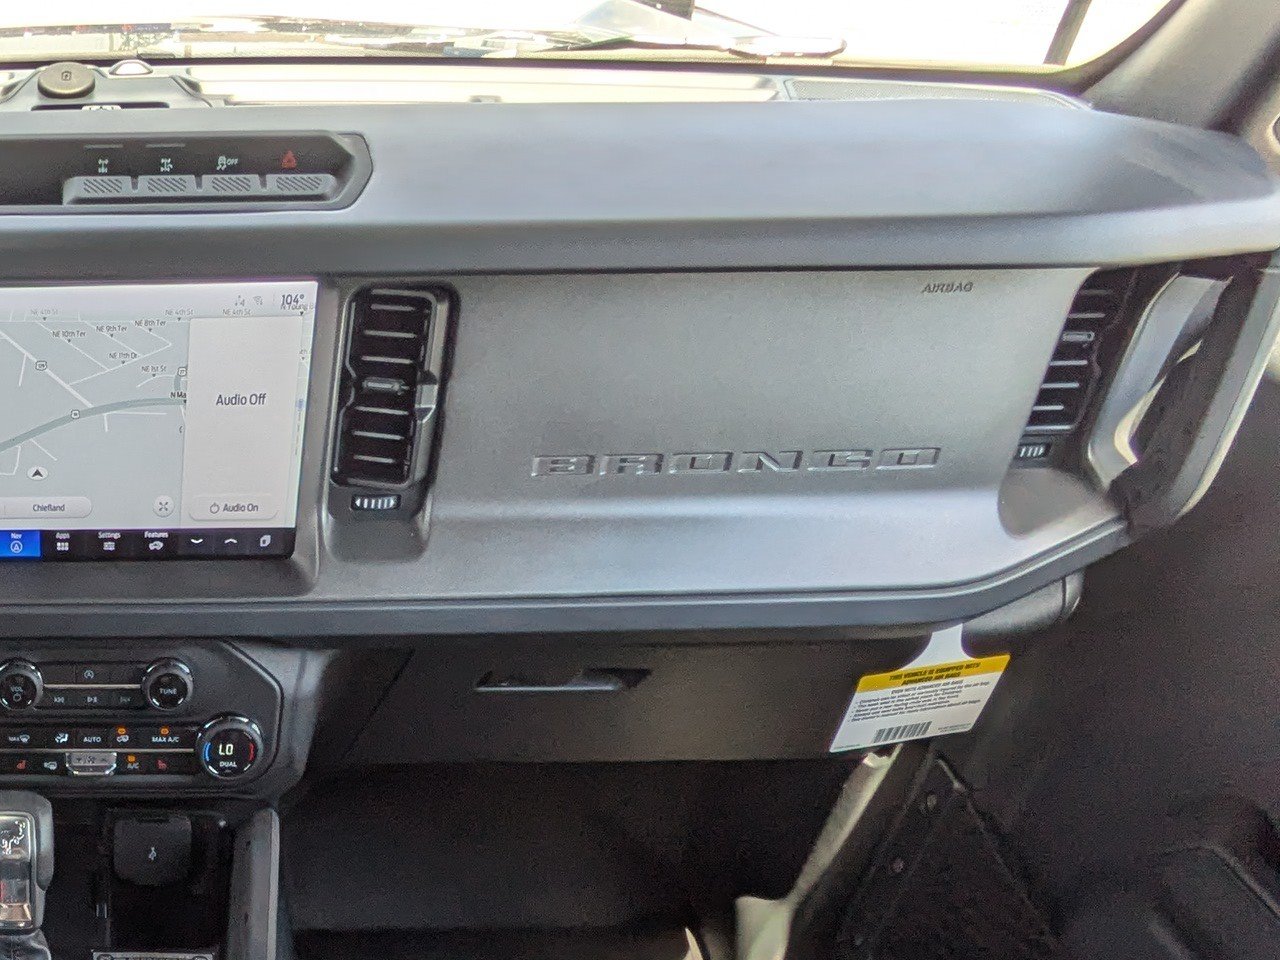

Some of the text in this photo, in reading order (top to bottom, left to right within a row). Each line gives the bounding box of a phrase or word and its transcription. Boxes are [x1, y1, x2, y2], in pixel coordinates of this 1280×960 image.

[226, 157, 239, 166] OFF
[920, 281, 974, 293] AIRBAG
[215, 392, 267, 406] Audio Off
[531, 446, 942, 477] BRONCO
[32, 503, 66, 512] Chiefland
[223, 503, 259, 512] Audio On
[55, 532, 70, 540] Apps
[98, 531, 122, 539] Settings
[144, 531, 169, 539] Features
[902, 670, 927, 678] VEHICLE
[219, 743, 234, 755] LO
[126, 762, 139, 770] A/C
